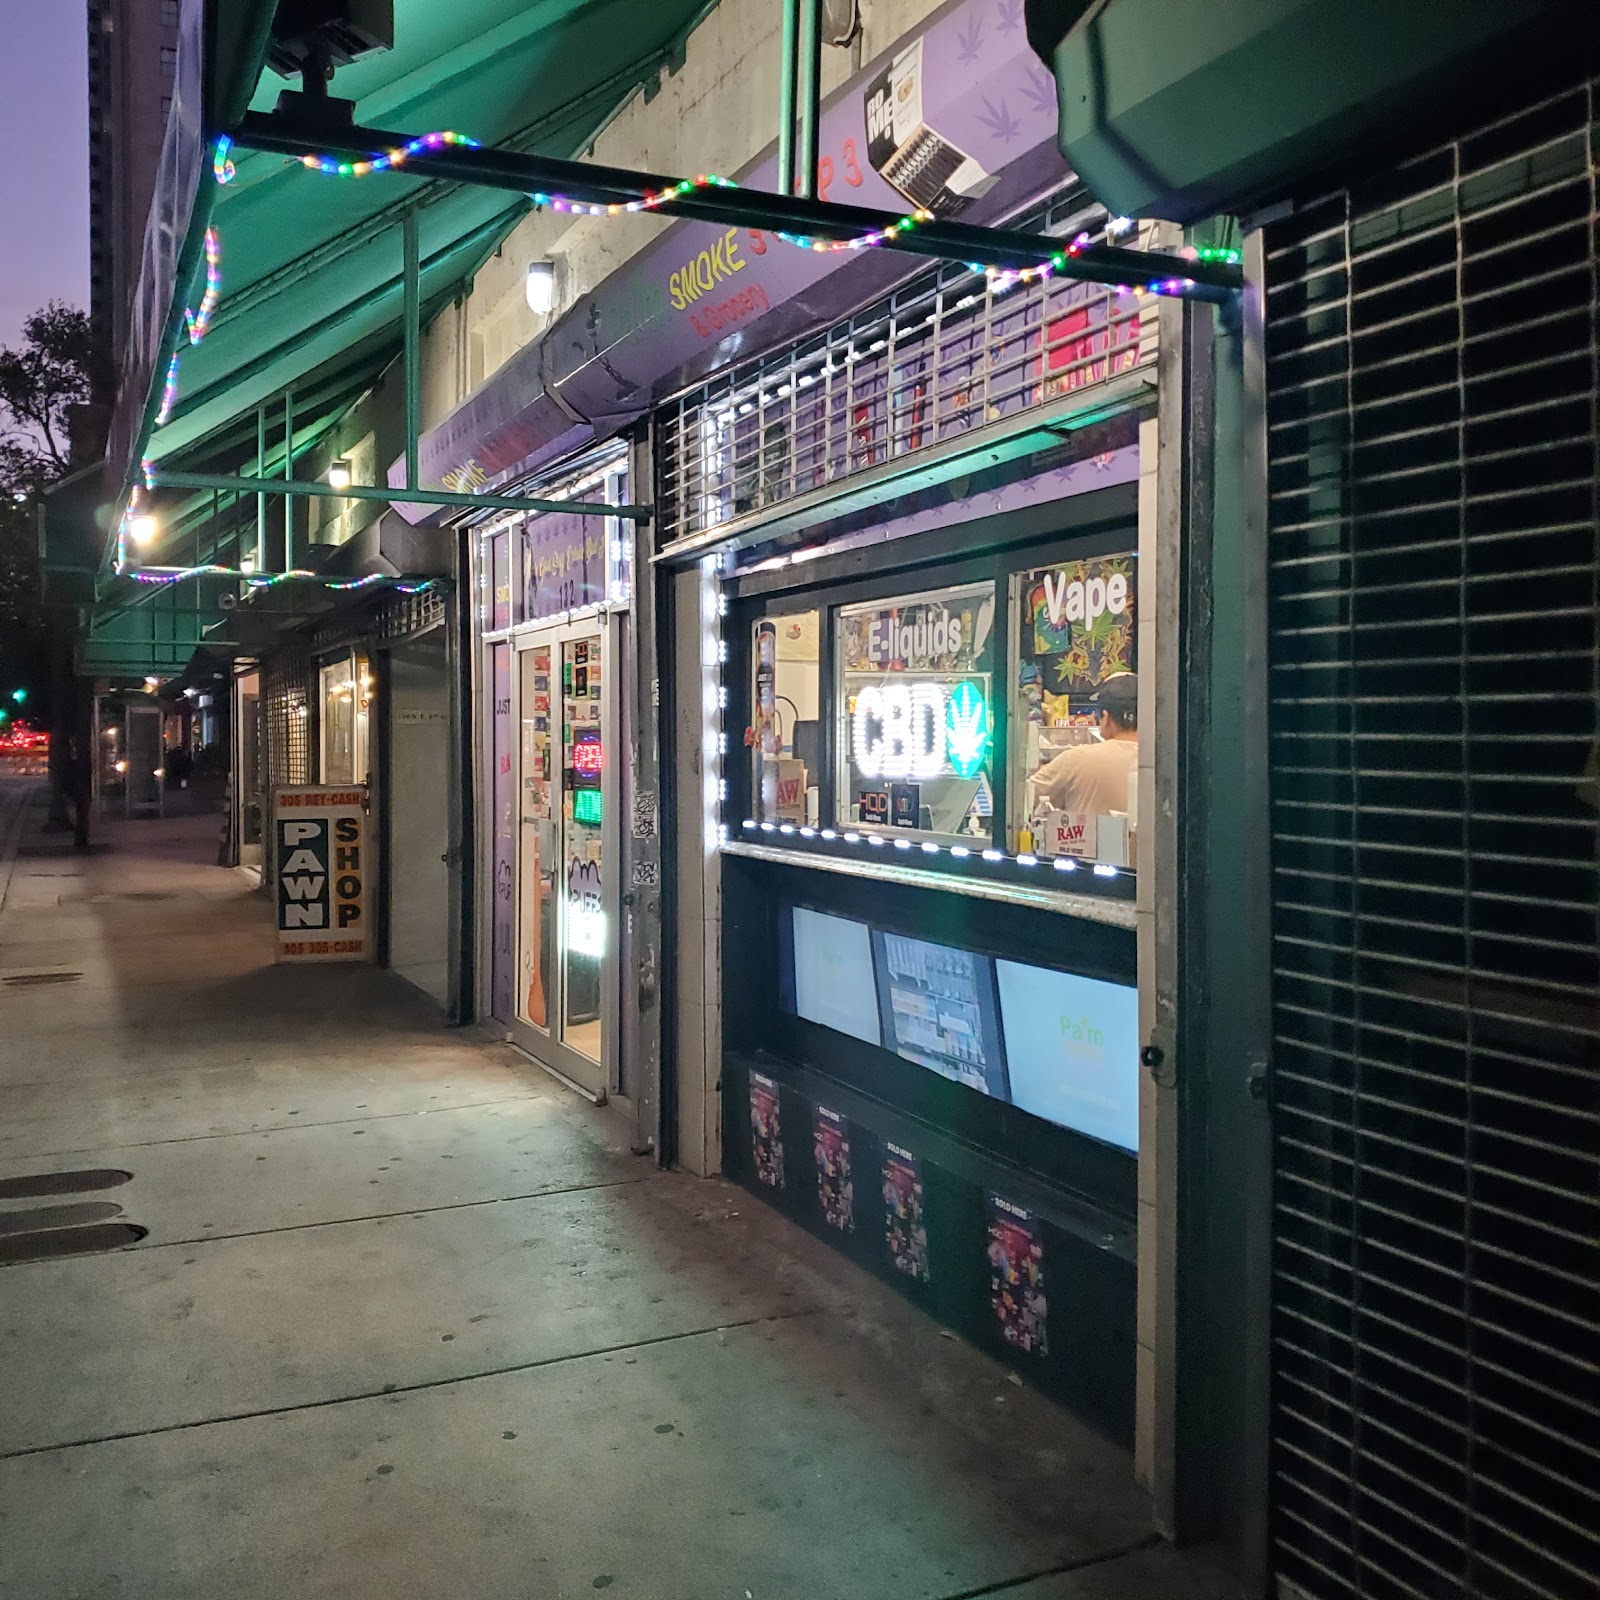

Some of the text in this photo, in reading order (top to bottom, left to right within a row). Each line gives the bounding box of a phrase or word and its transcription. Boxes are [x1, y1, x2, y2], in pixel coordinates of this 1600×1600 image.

[669, 227, 747, 310] SMOKE
[841, 137, 864, 188] 3
[441, 458, 489, 493] SMOKE
[559, 579, 575, 609] 132
[1043, 572, 1128, 631] Vape
[868, 608, 962, 668] E-liquids
[853, 683, 948, 779] CBD
[280, 792, 360, 807] 305 REY-CASH
[858, 792, 888, 813] HQD
[1056, 825, 1084, 841] RAW
[282, 822, 326, 927] PAWN
[335, 817, 362, 928] SHOP
[284, 941, 362, 955] 305 305-CASH
[994, 1197, 1029, 1221] SOLD HERE
